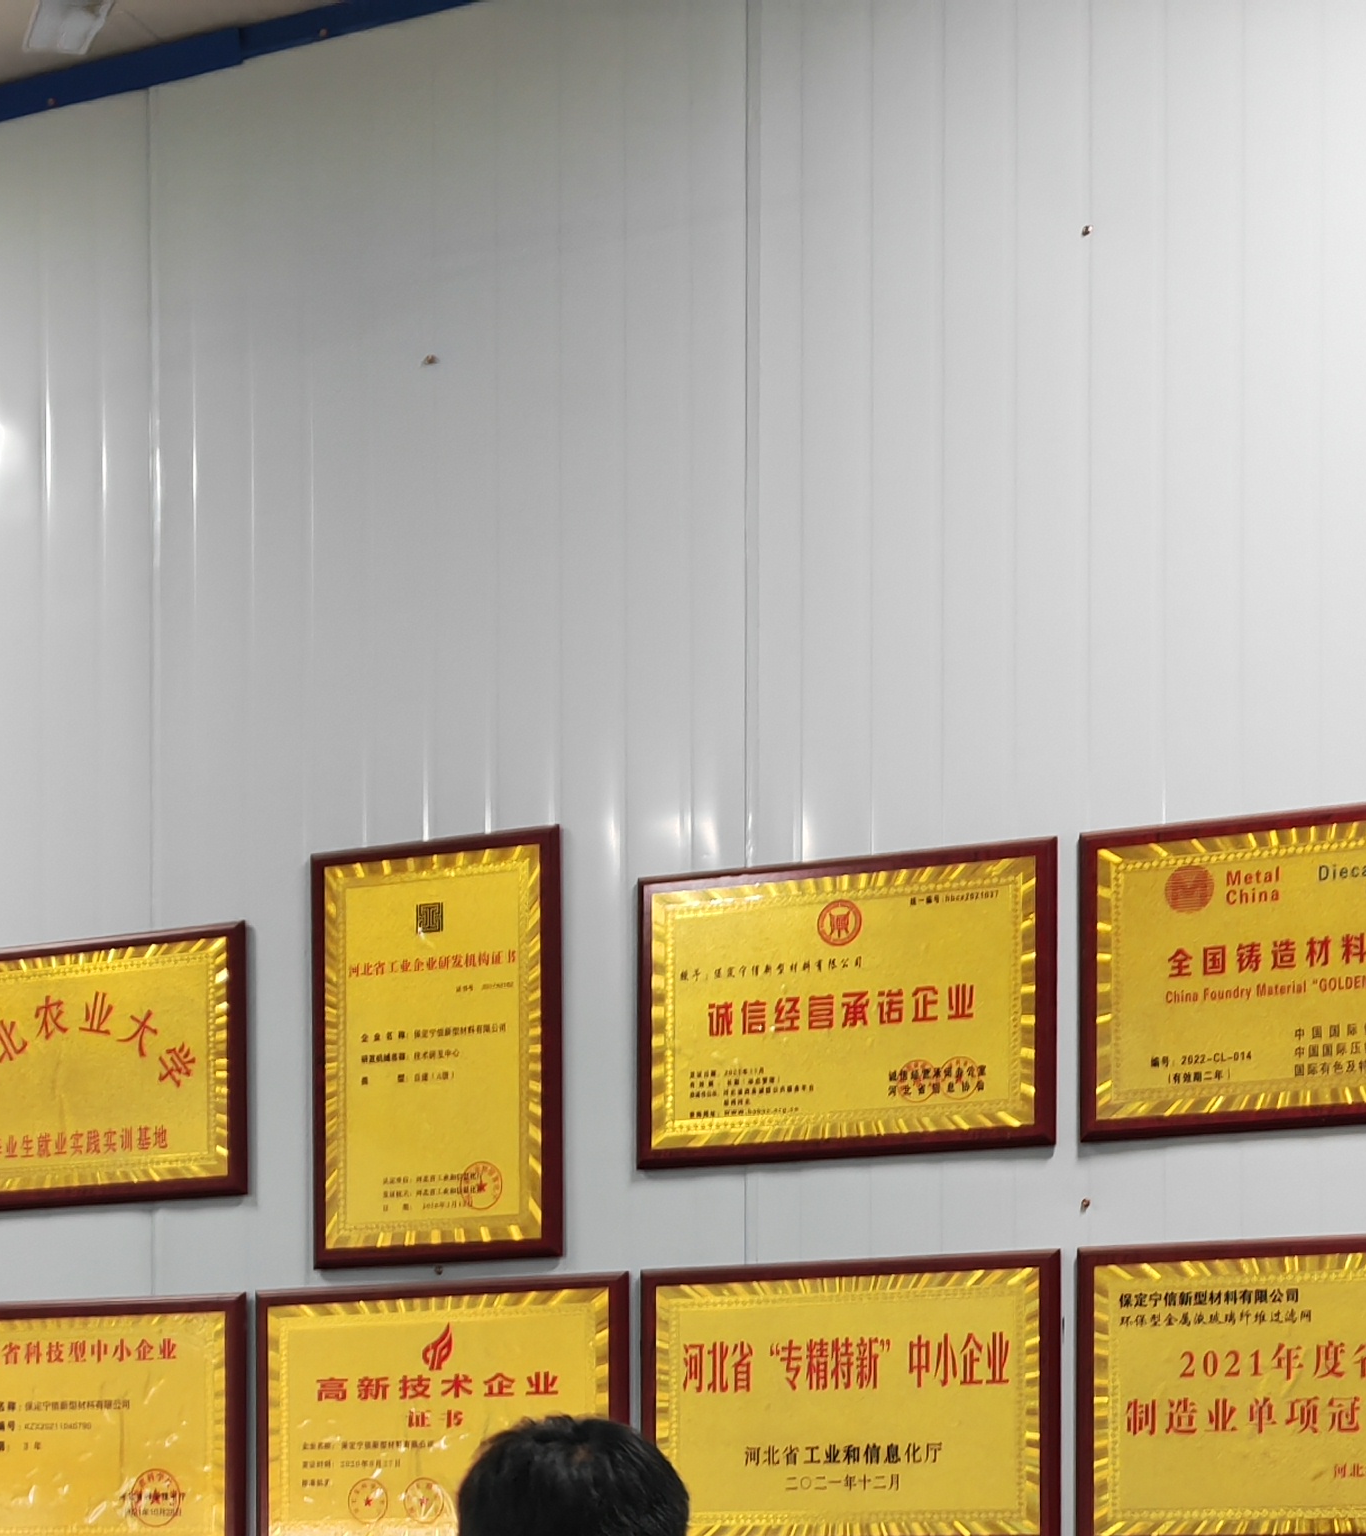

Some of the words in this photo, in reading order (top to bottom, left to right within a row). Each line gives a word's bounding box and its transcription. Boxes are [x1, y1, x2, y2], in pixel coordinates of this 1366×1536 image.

[1225, 865, 1281, 887] Metal
[1225, 888, 1281, 905] China
[349, 949, 517, 978] 河北省工业企业研发机构证书
[1165, 989, 1199, 1005] China
[1203, 985, 1252, 1004] Foundry
[1256, 979, 1307, 998] Material
[708, 983, 975, 1037] 诚信经营承诺企业
[1119, 1287, 1300, 1309] 保定宁信新型材料有限公司
[1119, 1308, 1312, 1328] 环保型金属液玻璃纤维过滤网
[683, 1331, 1010, 1394] 河北省“专精特新”中小企业
[316, 1371, 559, 1401] 高新技术企业
[408, 1409, 464, 1429] 证书
[744, 1441, 943, 1466] 河北省工业和信息化厅
